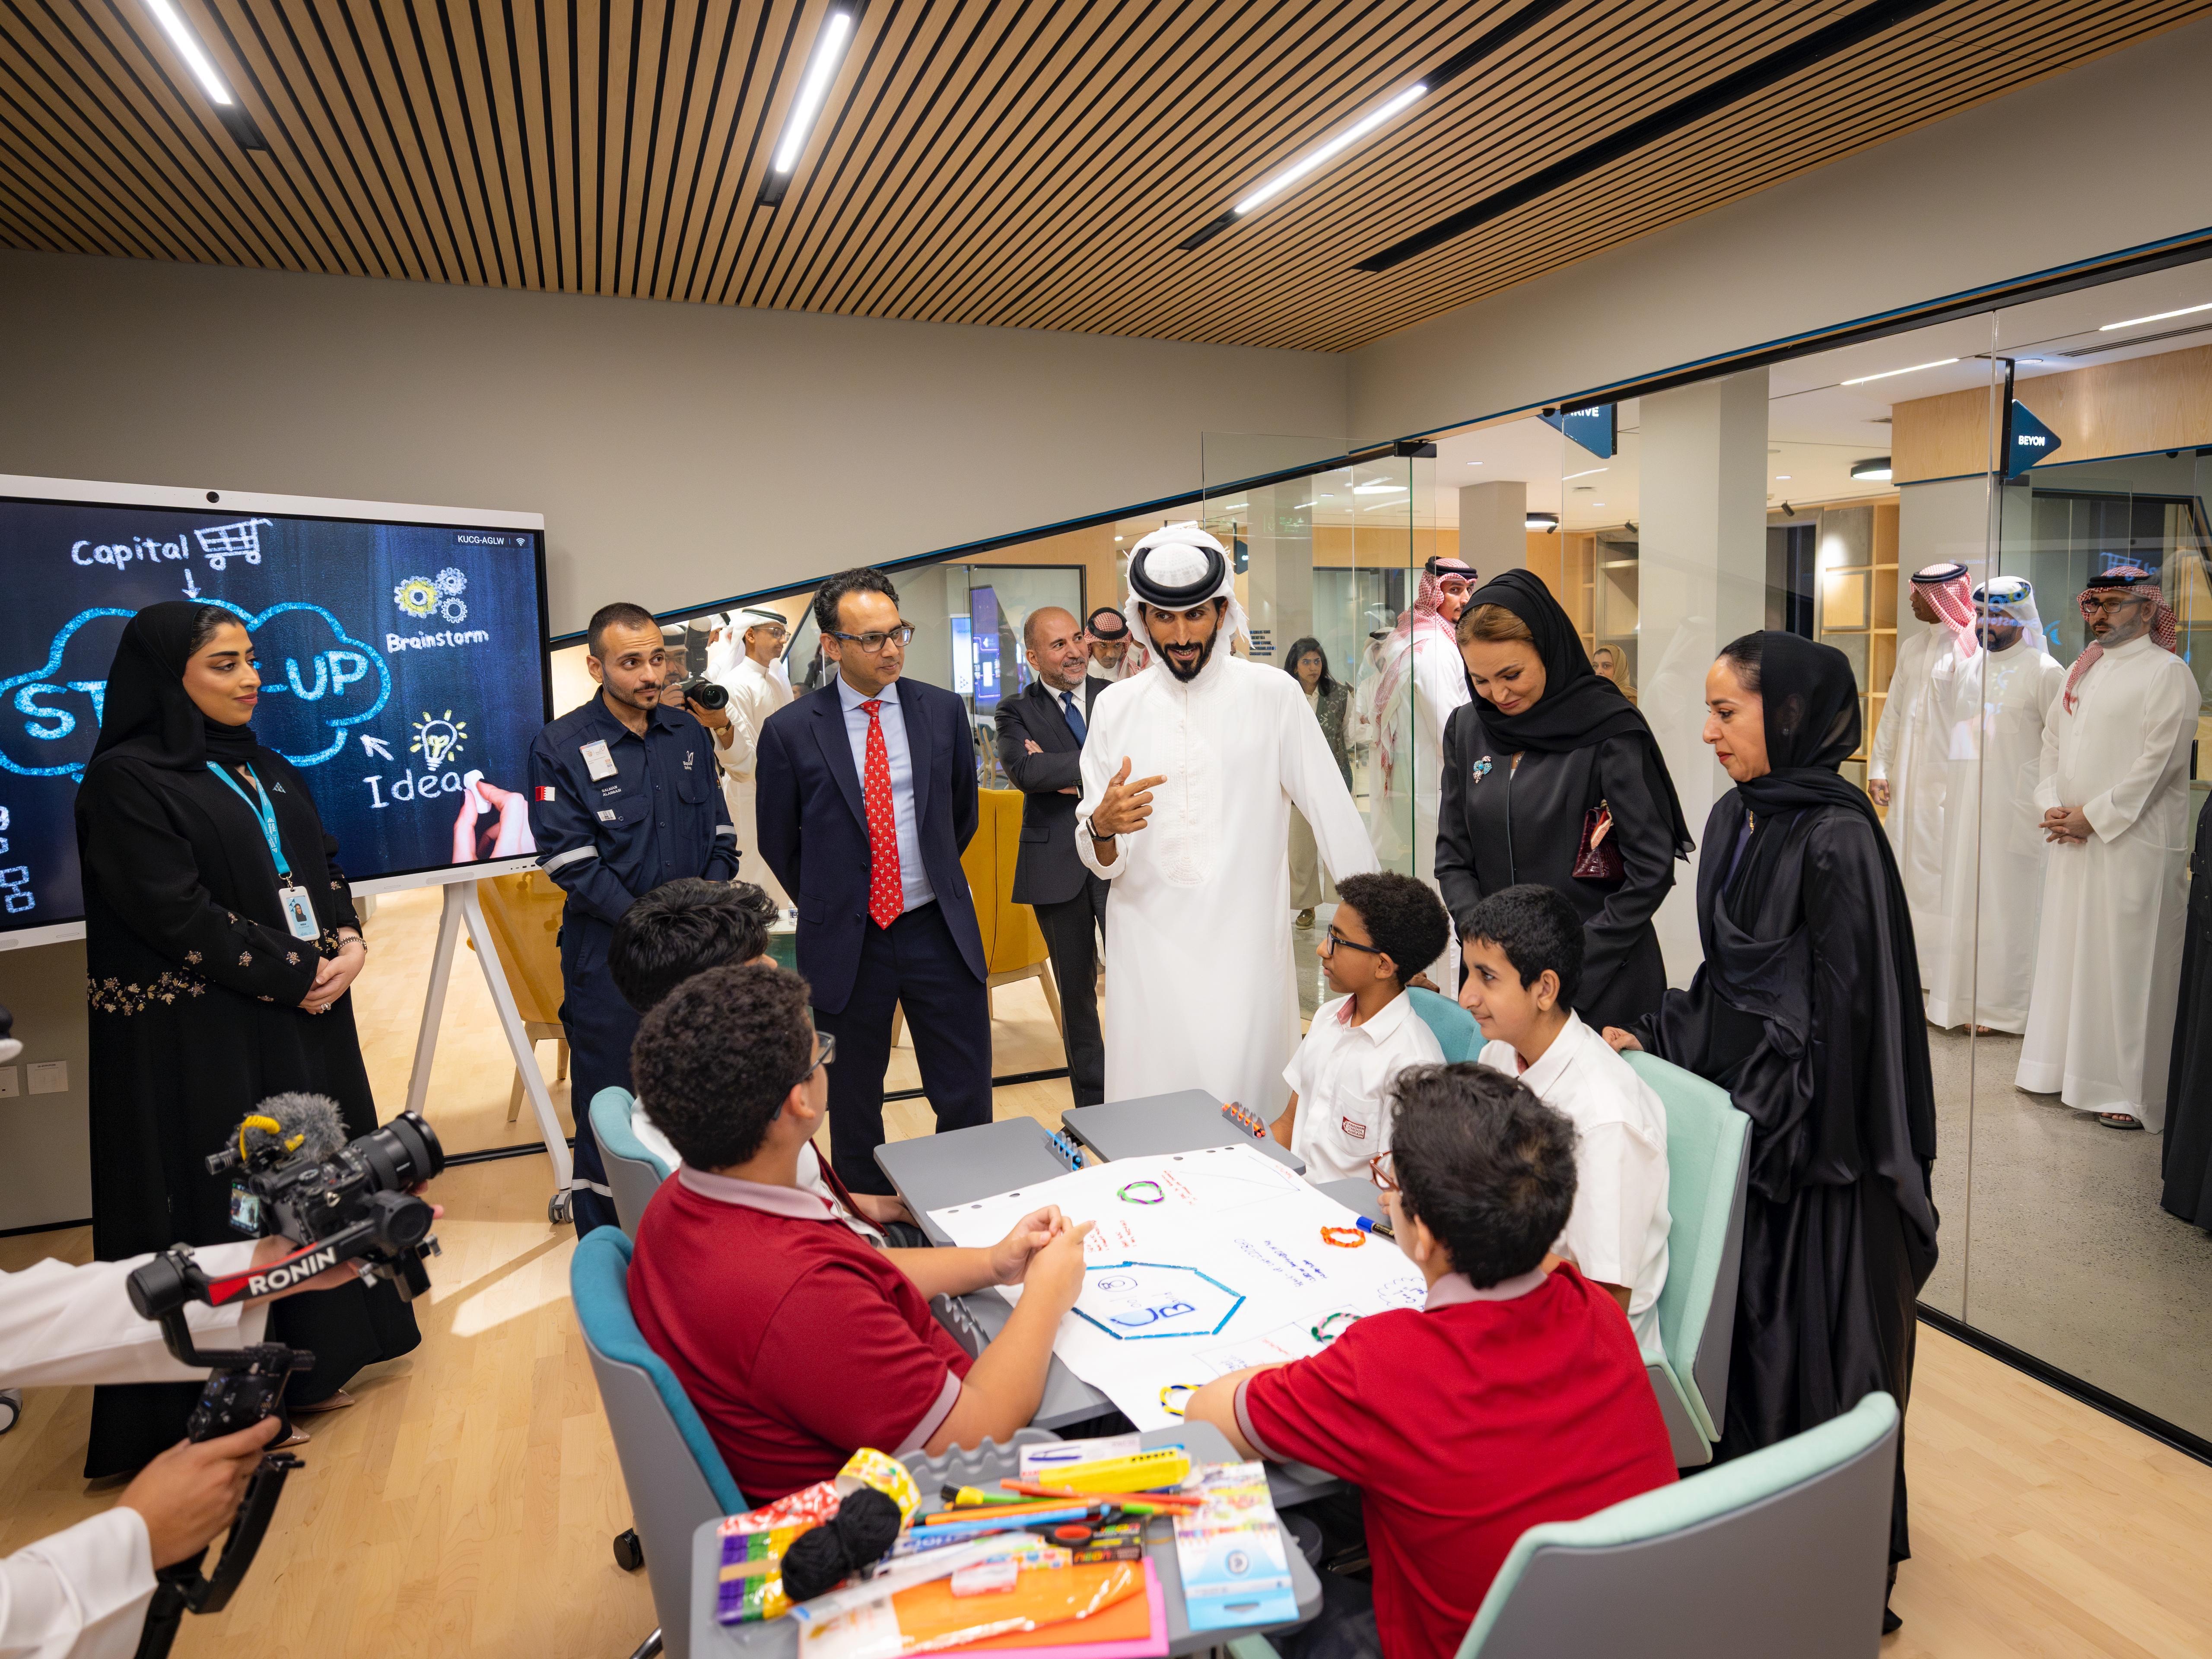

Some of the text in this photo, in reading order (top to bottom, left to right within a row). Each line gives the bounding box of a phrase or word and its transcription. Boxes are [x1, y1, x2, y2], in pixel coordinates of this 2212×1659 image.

[2018, 435, 2045, 446] BEYON
[71, 534, 189, 570] Capital
[458, 535, 504, 545] KUCG-AGLW
[386, 630, 489, 653] Brainstorm
[363, 769, 465, 808] Idea
[248, 1246, 336, 1296] RONIN
